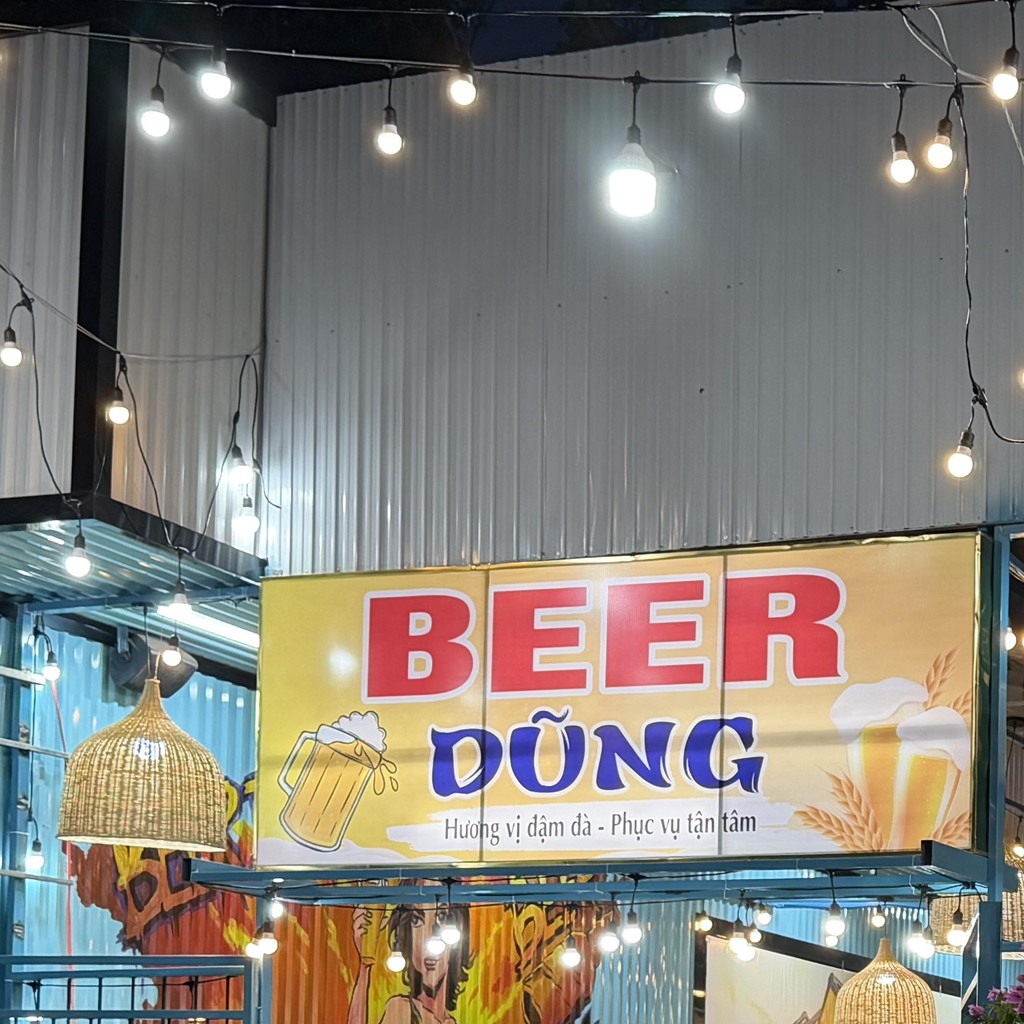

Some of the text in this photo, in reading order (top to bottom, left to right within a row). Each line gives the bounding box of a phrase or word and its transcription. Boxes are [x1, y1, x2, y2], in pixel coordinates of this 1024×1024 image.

[365, 571, 846, 700] BEER
[431, 707, 764, 797] DŨNG
[444, 816, 500, 846] Hương
[506, 814, 521, 843] vị
[527, 813, 564, 843] đậm
[571, 812, 592, 837] đà
[611, 811, 654, 841] Phục
[661, 814, 681, 840] vụ
[688, 810, 715, 840] tận
[722, 809, 757, 833] tâm
